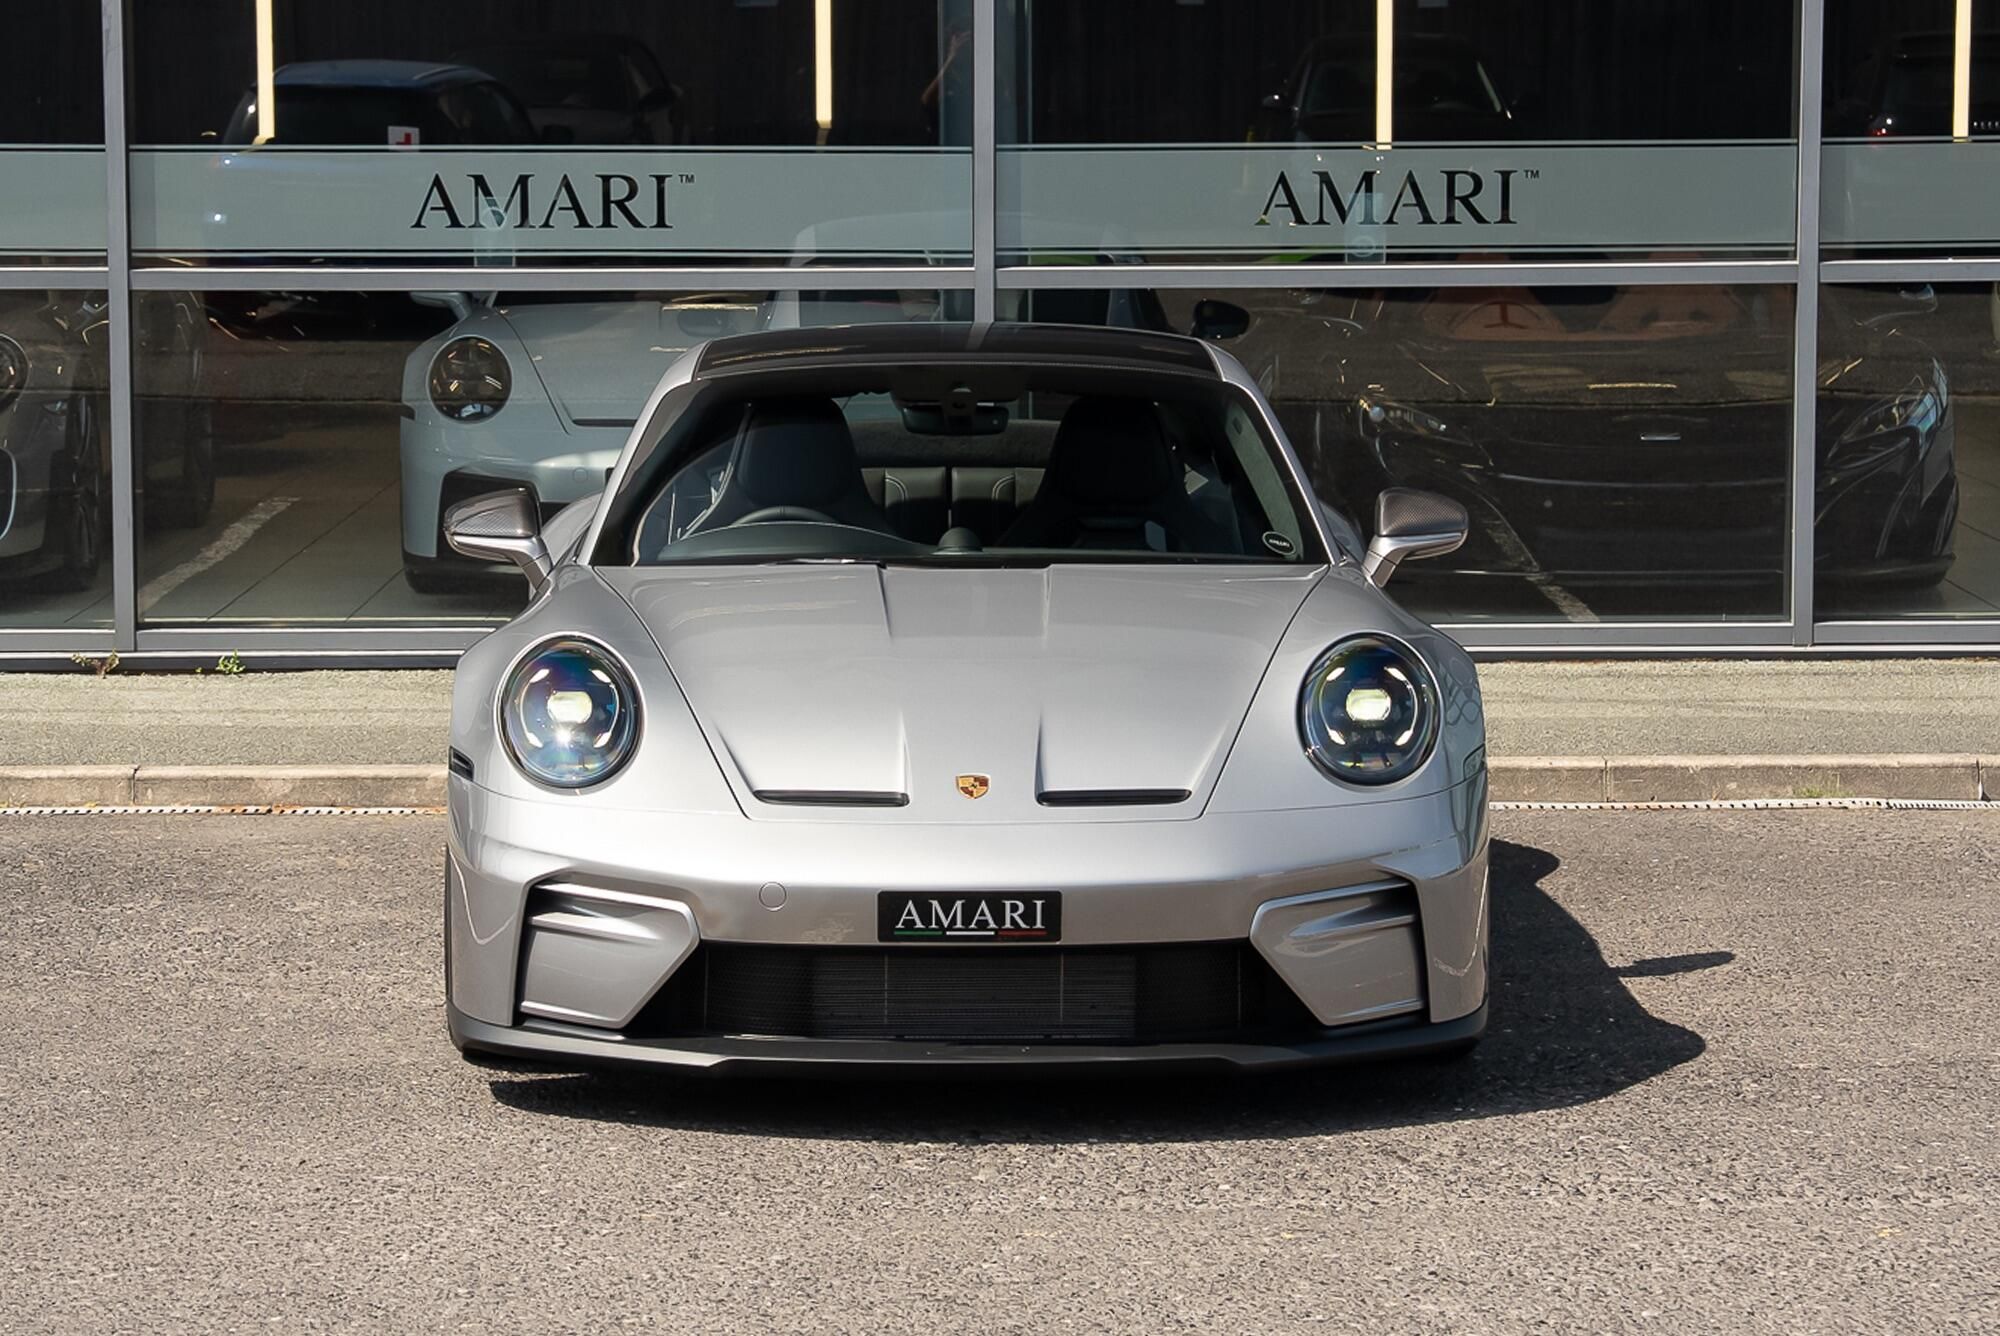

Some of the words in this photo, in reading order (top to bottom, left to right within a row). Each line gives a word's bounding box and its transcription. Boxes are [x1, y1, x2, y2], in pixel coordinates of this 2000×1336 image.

[410, 173, 673, 229] AMARI
[1254, 169, 1518, 225] AMARI
[895, 899, 1046, 929] AMARI
